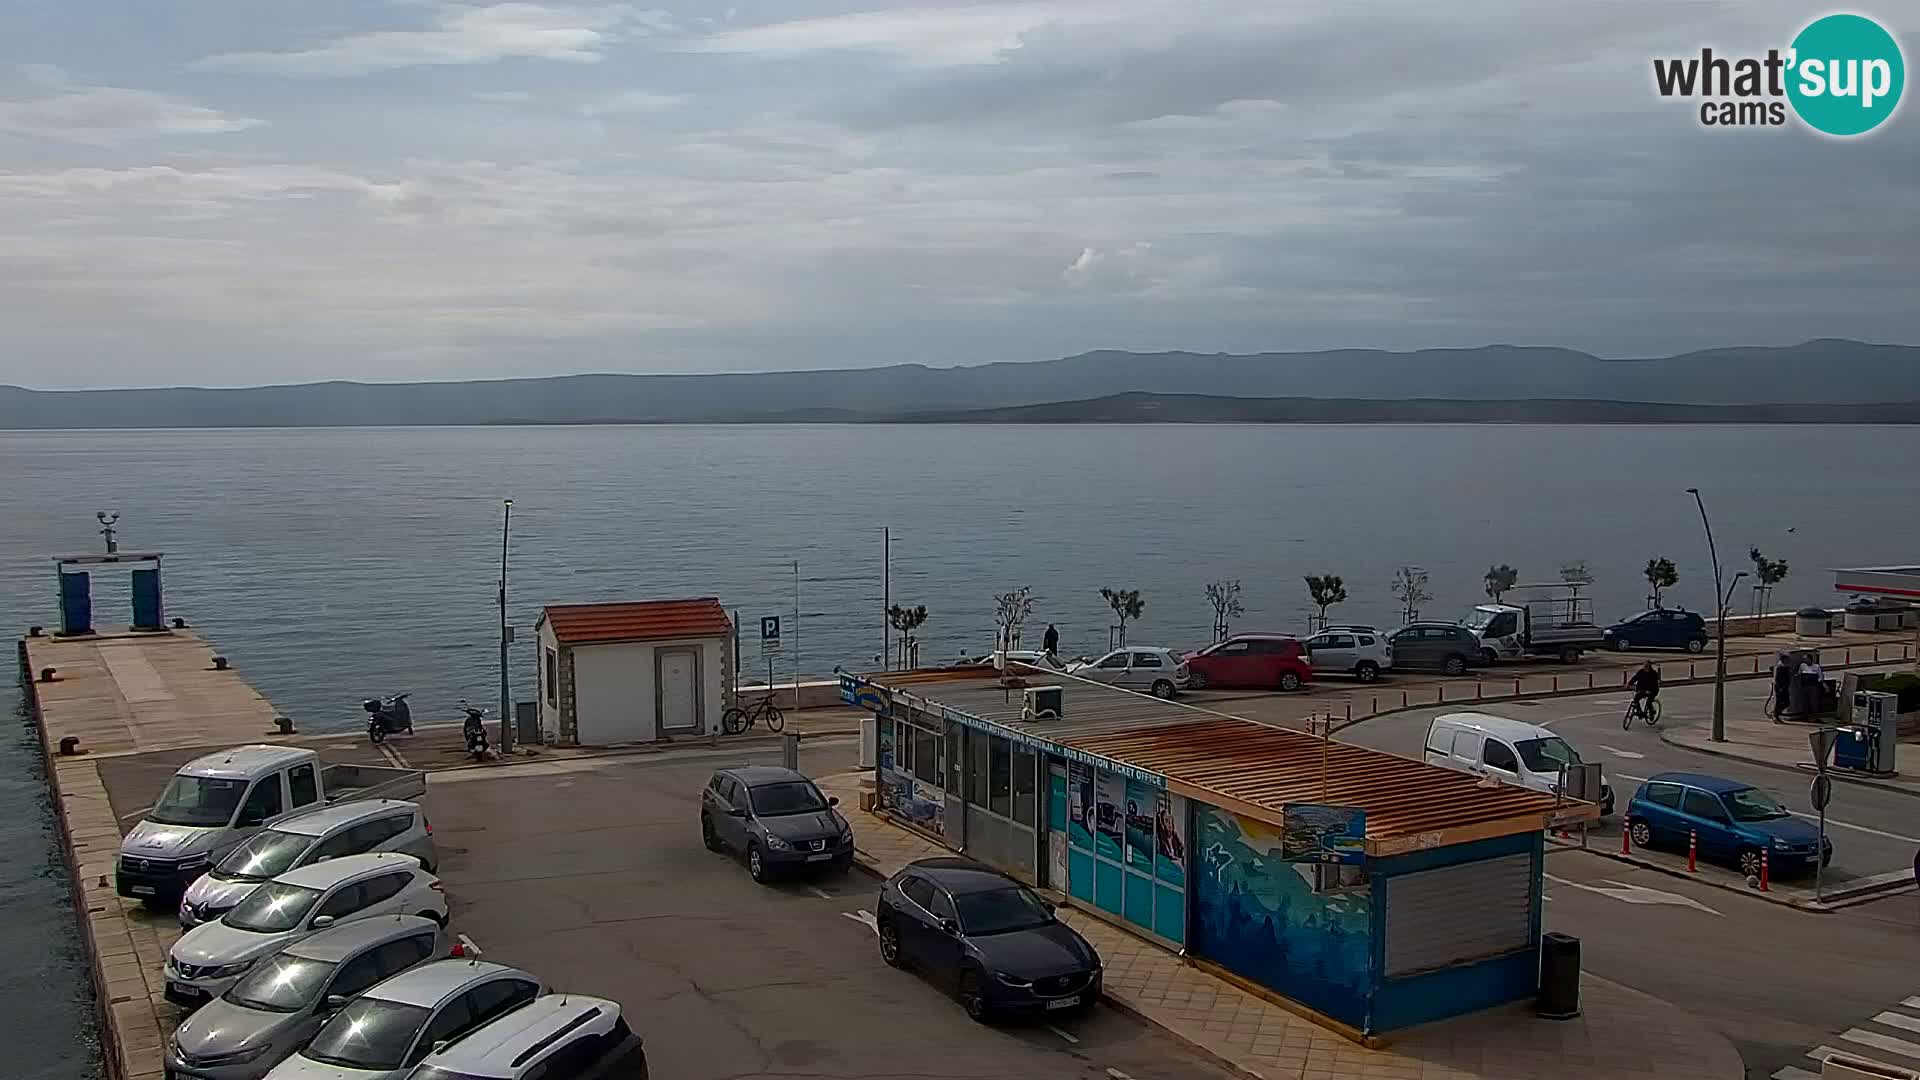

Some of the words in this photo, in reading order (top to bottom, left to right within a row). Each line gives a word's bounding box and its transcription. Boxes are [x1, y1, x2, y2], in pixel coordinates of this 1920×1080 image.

[766, 620, 775, 635] P
[1063, 747, 1077, 759] BUS
[1079, 752, 1109, 770] STATION
[1111, 762, 1135, 778] TICKET
[1136, 769, 1161, 786] OFFICE
